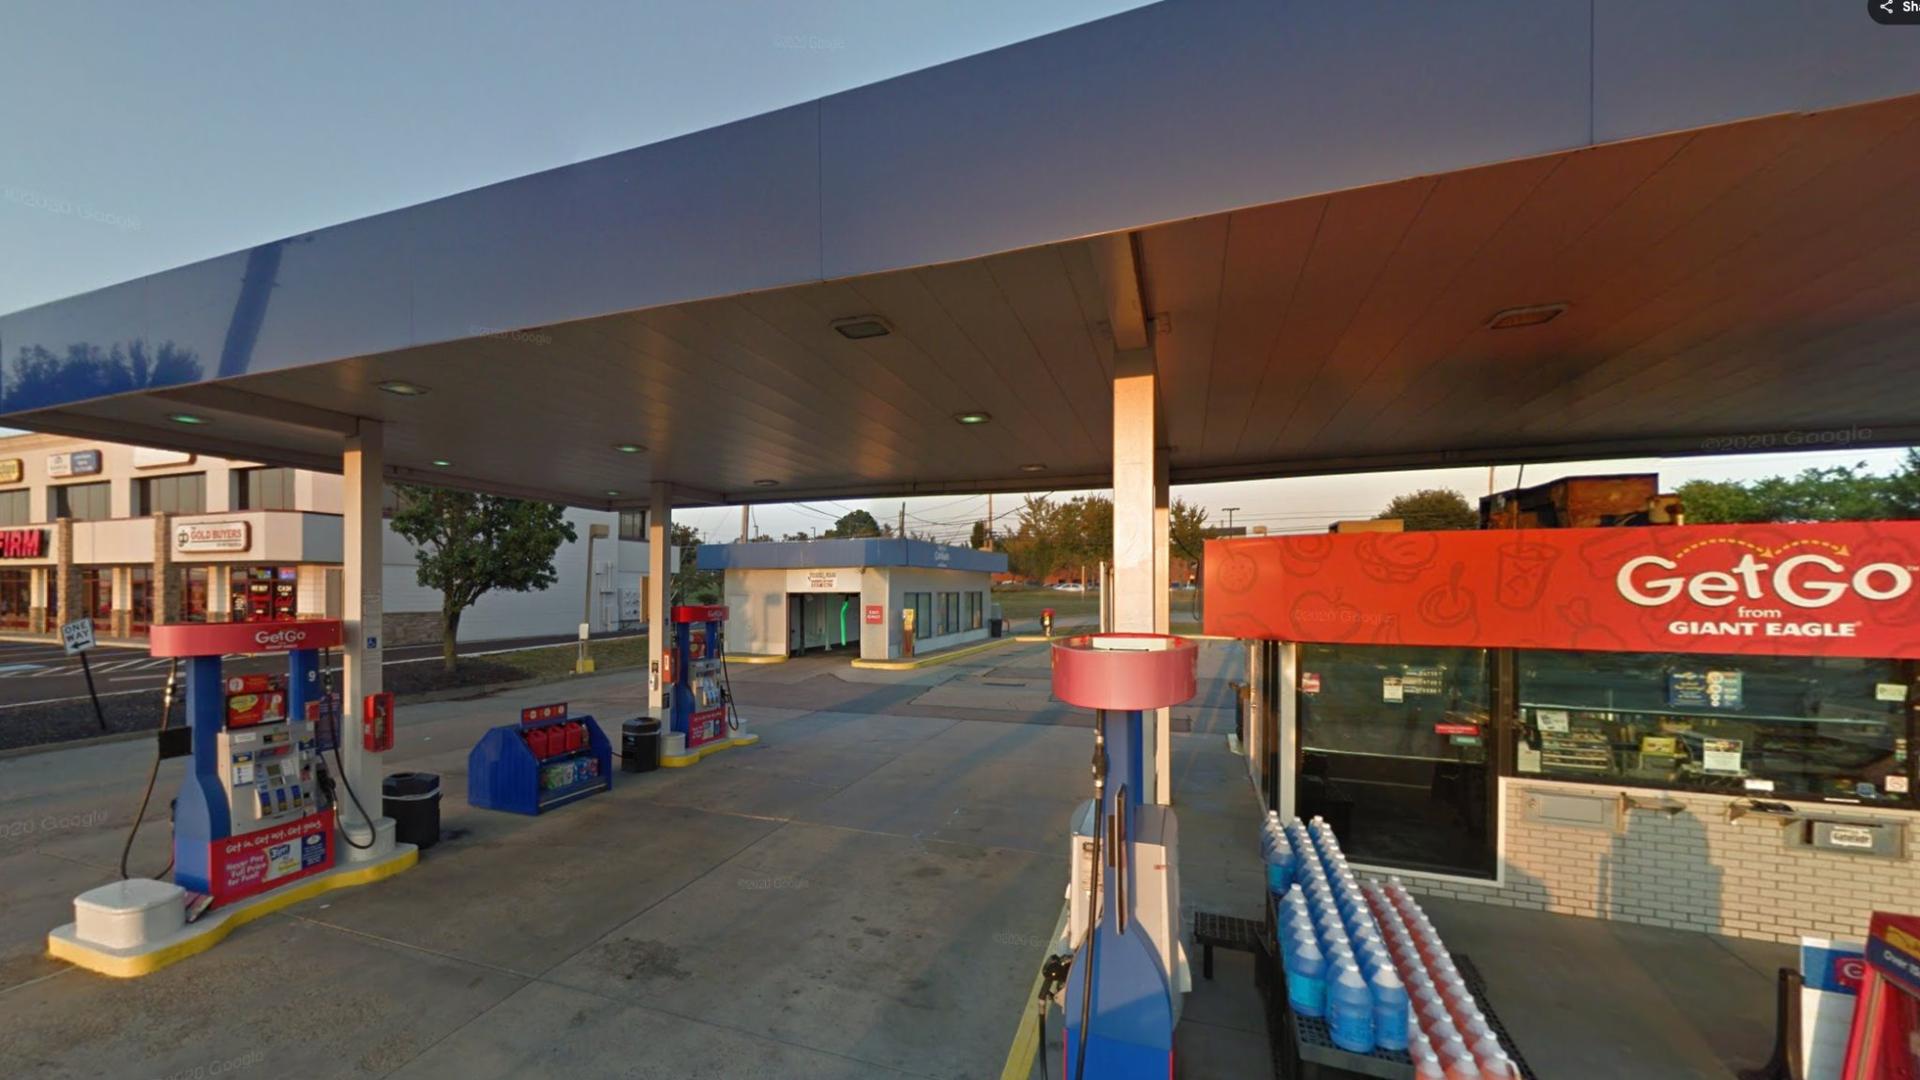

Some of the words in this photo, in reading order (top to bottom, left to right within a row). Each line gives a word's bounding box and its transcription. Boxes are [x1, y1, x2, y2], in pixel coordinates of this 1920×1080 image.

[1616, 553, 1913, 608] GetGo
[1737, 606, 1782, 619] from
[64, 620, 88, 634] ONE
[1668, 620, 1758, 636] GIANT
[1765, 622, 1857, 637] EAGLE
[66, 630, 89, 642] WAY
[255, 630, 306, 644] GetGo
[308, 670, 316, 682] 9
